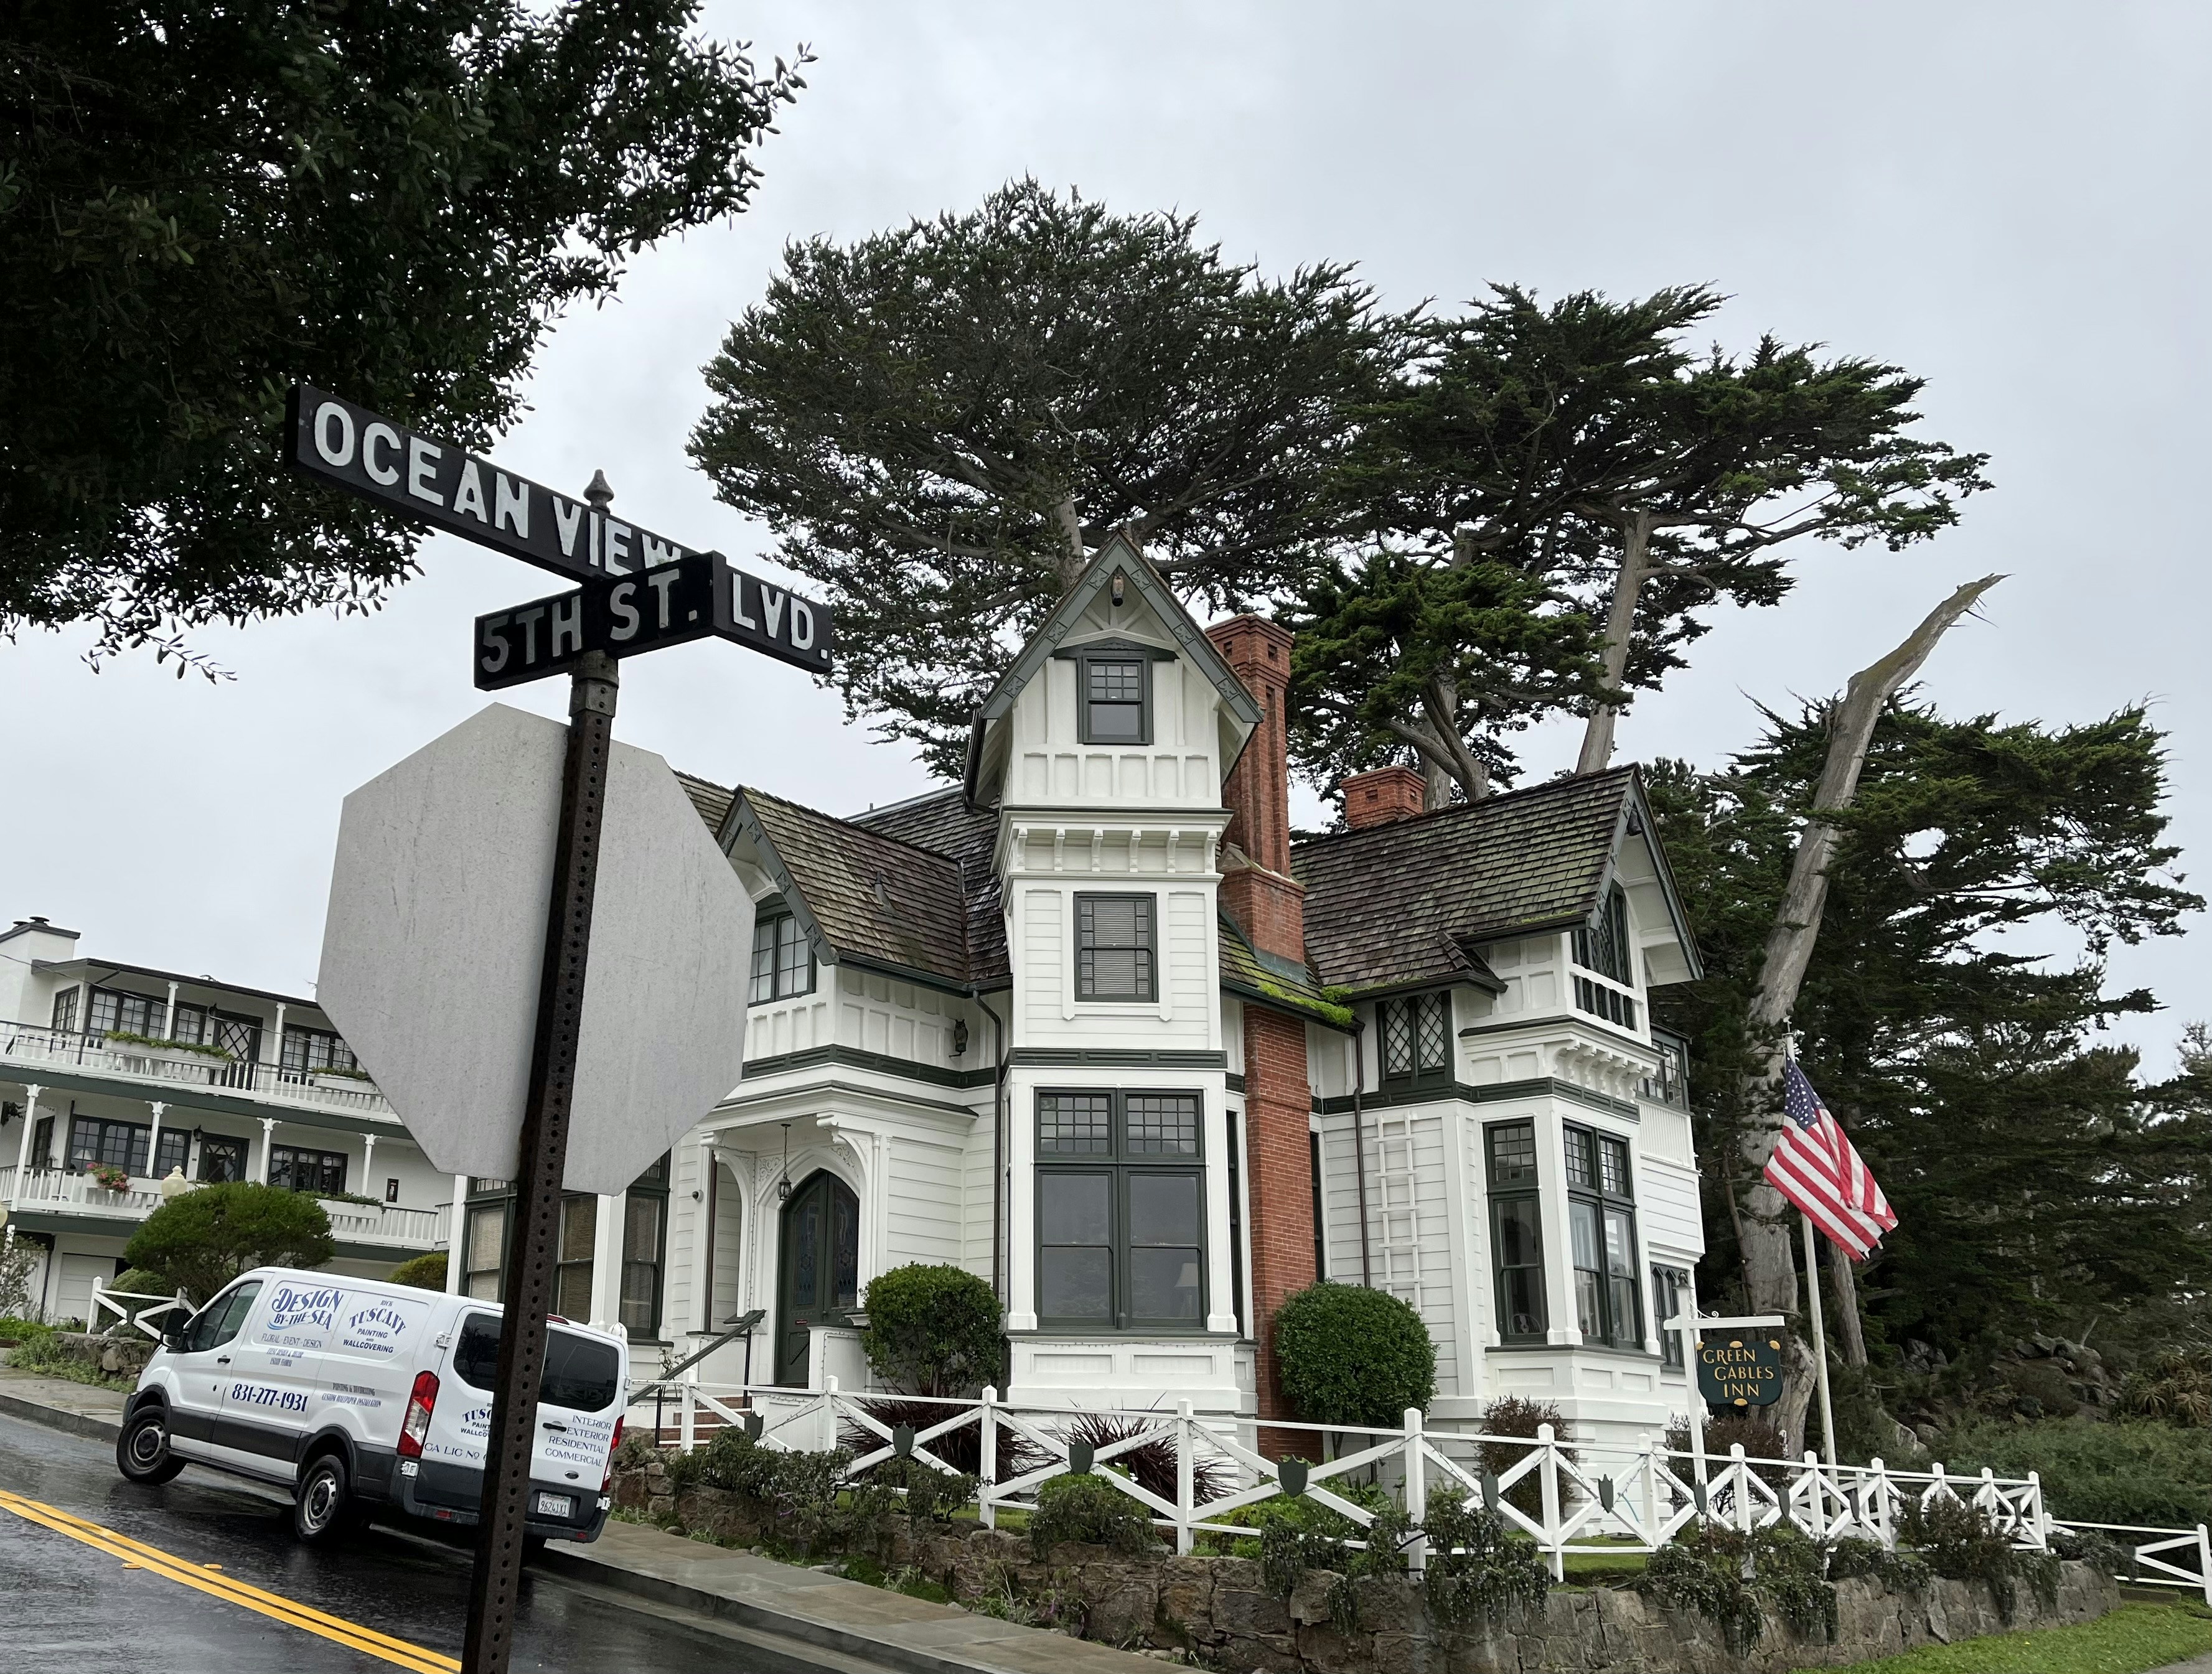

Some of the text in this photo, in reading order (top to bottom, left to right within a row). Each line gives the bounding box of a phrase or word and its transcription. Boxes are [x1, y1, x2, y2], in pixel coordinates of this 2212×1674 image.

[314, 401, 828, 660] OCEAN VIEW LVD.
[480, 569, 698, 673] 5TH ST.
[272, 1288, 344, 1312] DESIGN
[349, 1307, 406, 1336] TUSCANY
[261, 1333, 322, 1348] FLORAL EVENT DESIGN
[357, 1328, 388, 1338] PAINTING
[343, 1339, 393, 1353] WALLCOVERING
[1702, 1349, 1756, 1365] GREEN
[1714, 1366, 1774, 1381] GABLES
[232, 1383, 308, 1411] 831-277-1931
[1724, 1383, 1760, 1398] INN
[462, 1409, 492, 1423] TUSC
[573, 1415, 611, 1430] INTERIOR
[461, 1428, 490, 1438] WALLCO
[566, 1427, 609, 1442] EXTERIOR
[424, 1443, 439, 1452] CA
[444, 1446, 462, 1456] LIC
[549, 1436, 605, 1454] RESIDENTIAL
[545, 1447, 602, 1467] COMMERCIAL
